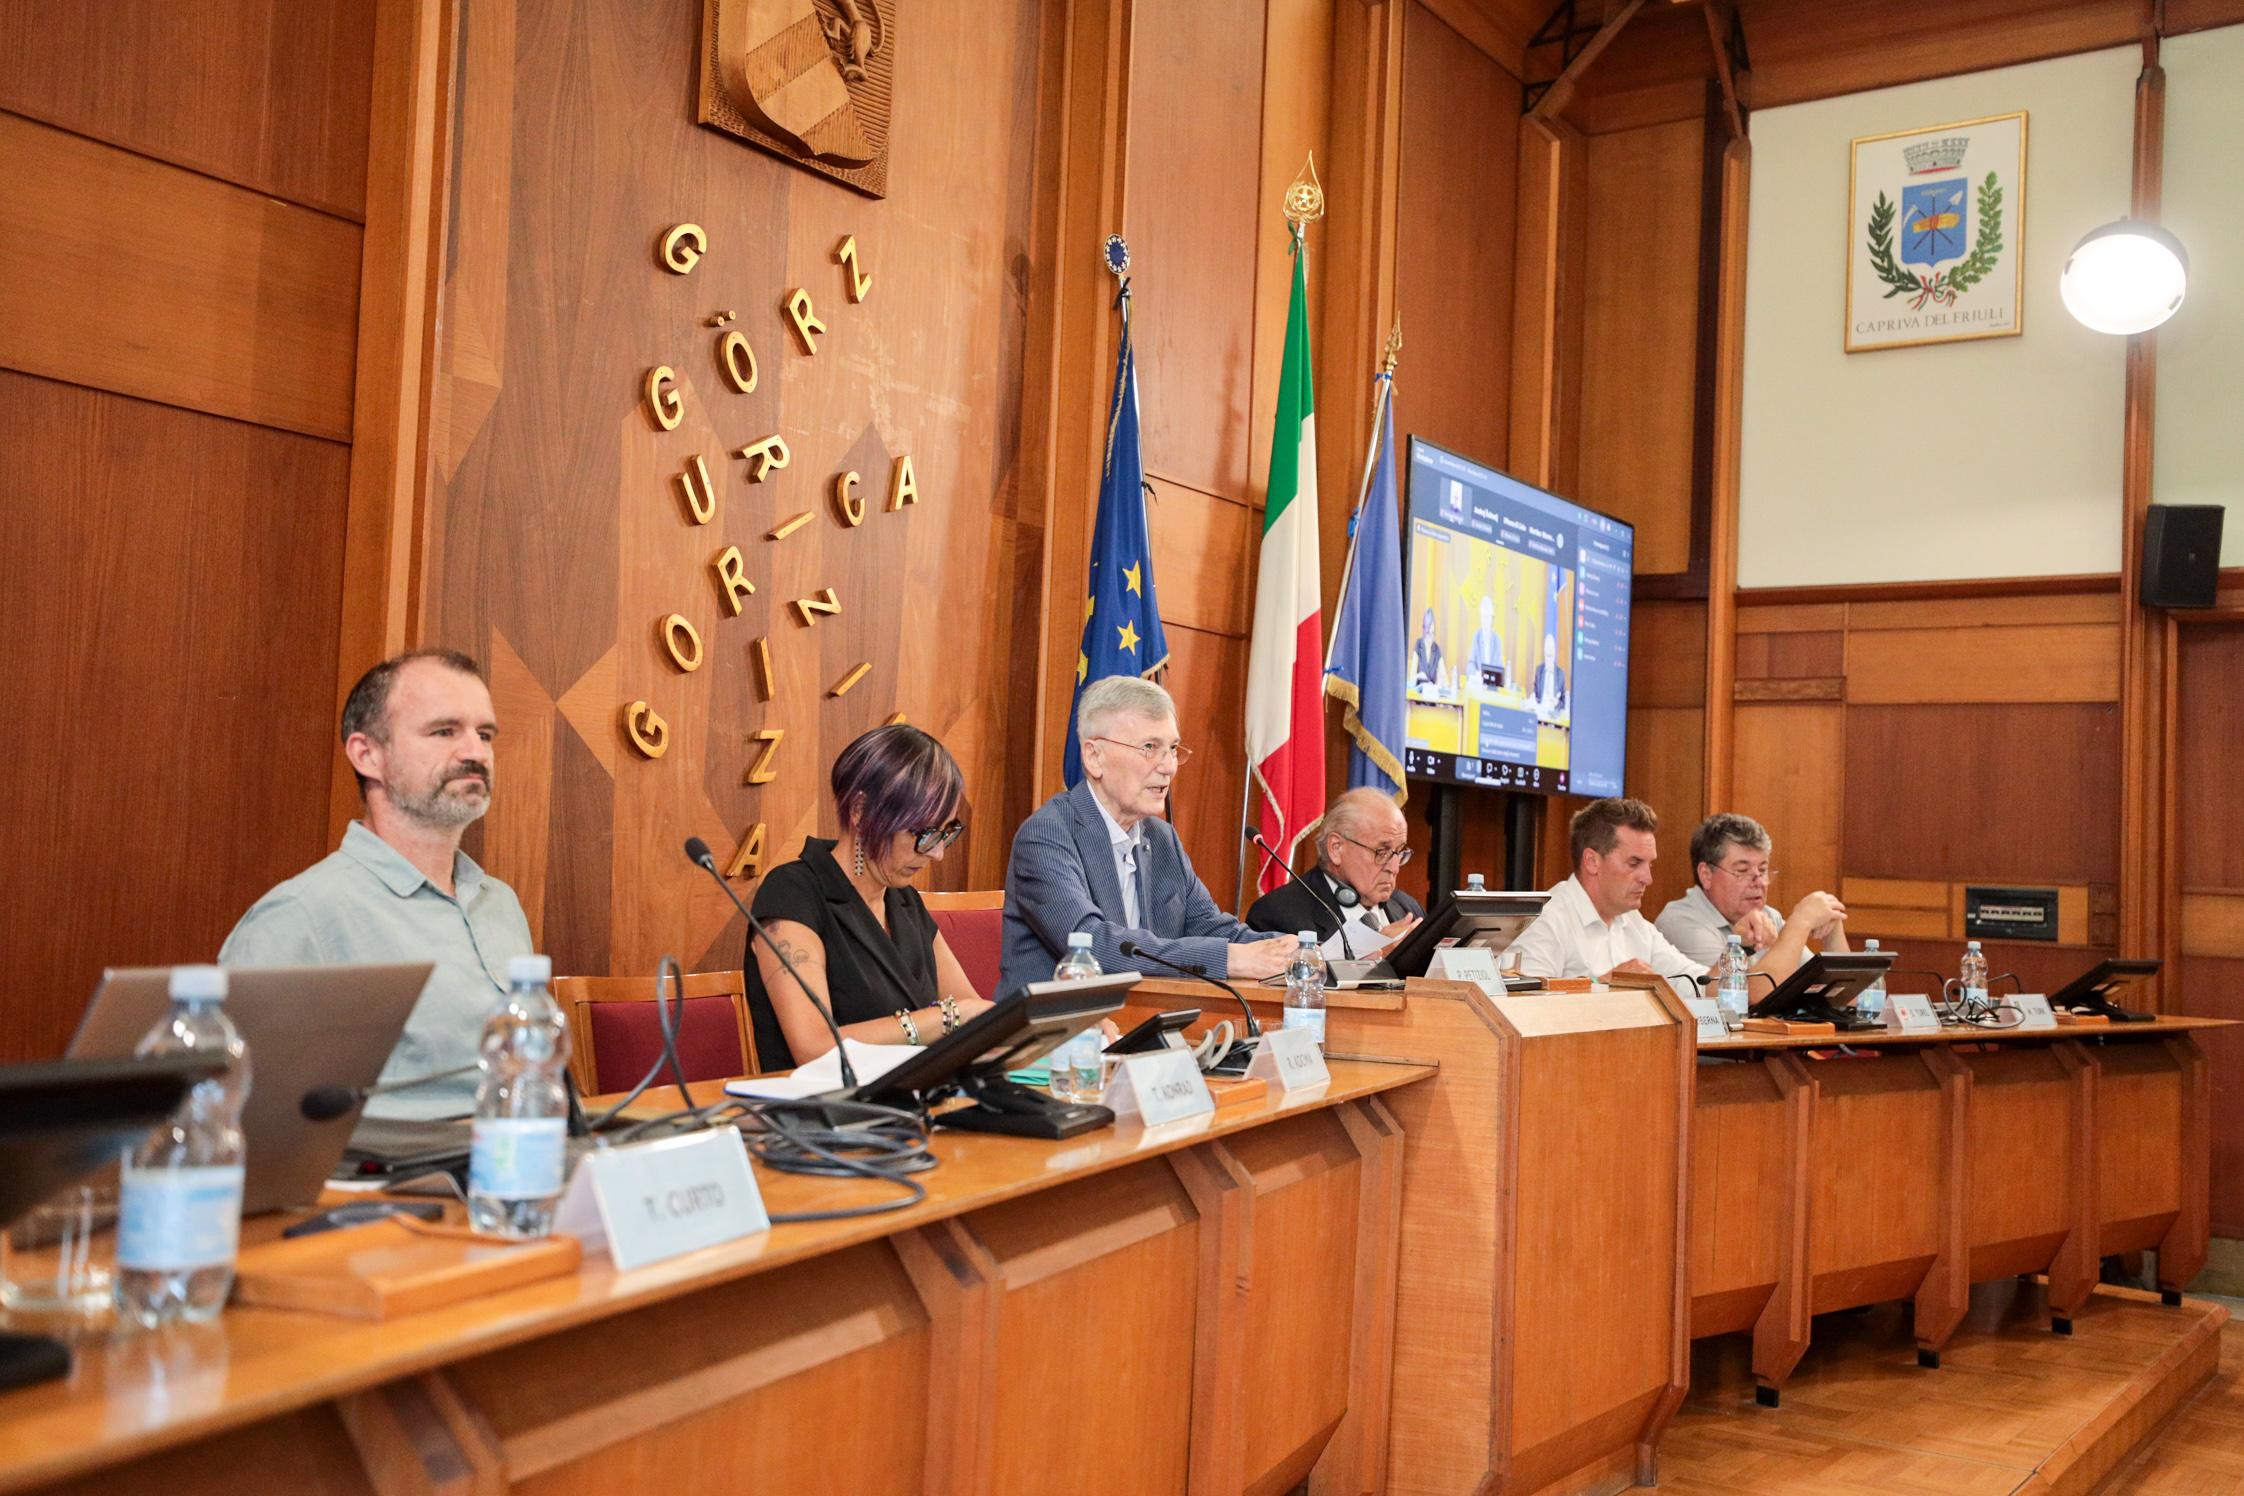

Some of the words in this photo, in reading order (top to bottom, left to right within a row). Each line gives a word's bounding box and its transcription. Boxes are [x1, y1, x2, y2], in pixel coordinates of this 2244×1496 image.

[1856, 316, 1920, 334] CAPRIVA
[1925, 313, 1948, 328] DEL
[1953, 307, 2003, 324] FRIULI
